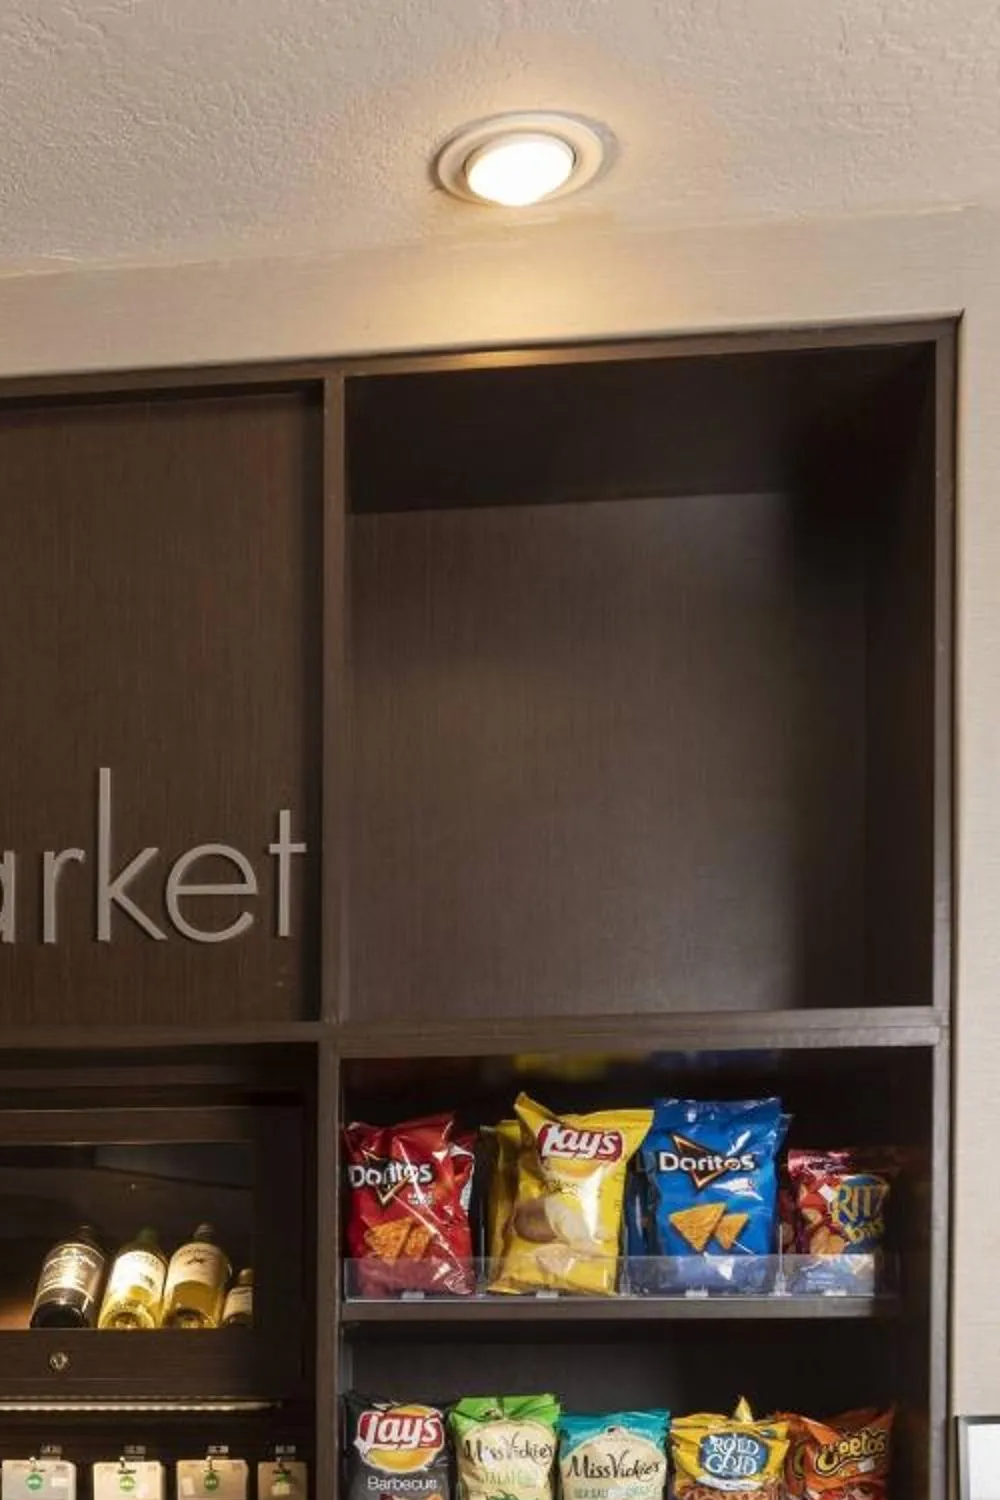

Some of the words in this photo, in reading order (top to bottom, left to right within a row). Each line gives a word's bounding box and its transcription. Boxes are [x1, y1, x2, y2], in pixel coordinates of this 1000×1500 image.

[659, 1151, 755, 1173] Doritos
[348, 1162, 433, 1188] Doritos
[365, 1411, 440, 1449] Lay's
[711, 1435, 760, 1457] ROLD
[567, 1454, 610, 1478] Miss
